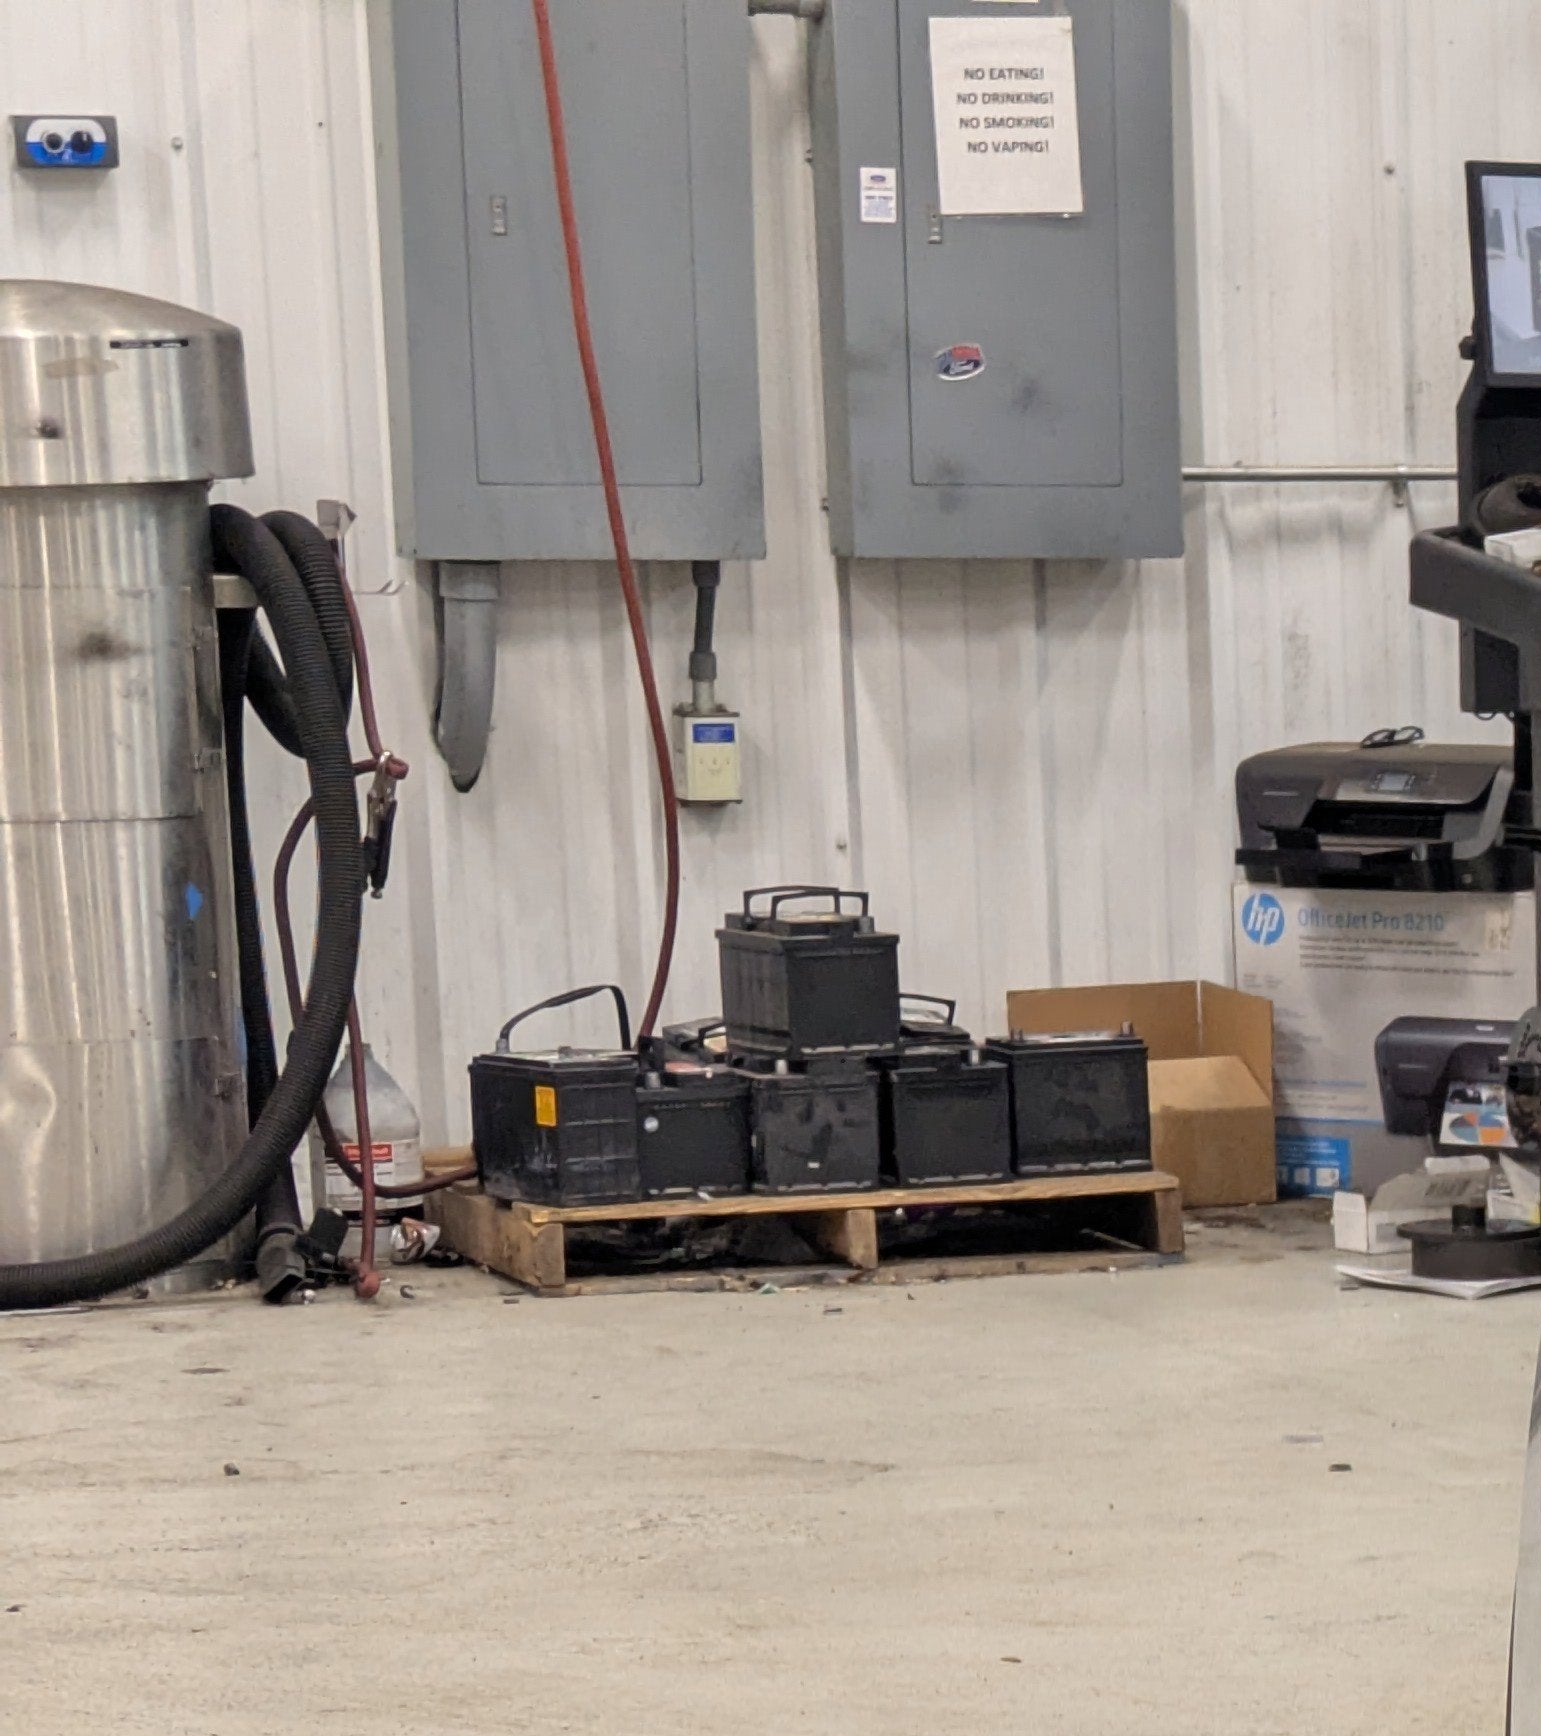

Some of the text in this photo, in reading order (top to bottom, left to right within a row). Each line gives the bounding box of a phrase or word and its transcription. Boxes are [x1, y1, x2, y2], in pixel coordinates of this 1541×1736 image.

[963, 67, 1044, 80] NO EATING!
[956, 91, 1054, 104] NO DRINKING!
[959, 115, 1055, 129] NO SMOKING!
[967, 139, 1049, 153] NO VAPING!
[1249, 893, 1281, 945] hp
[1298, 906, 1368, 929] OfficeJet
[1372, 910, 1400, 930] Pro
[1404, 913, 1444, 932] 8210
